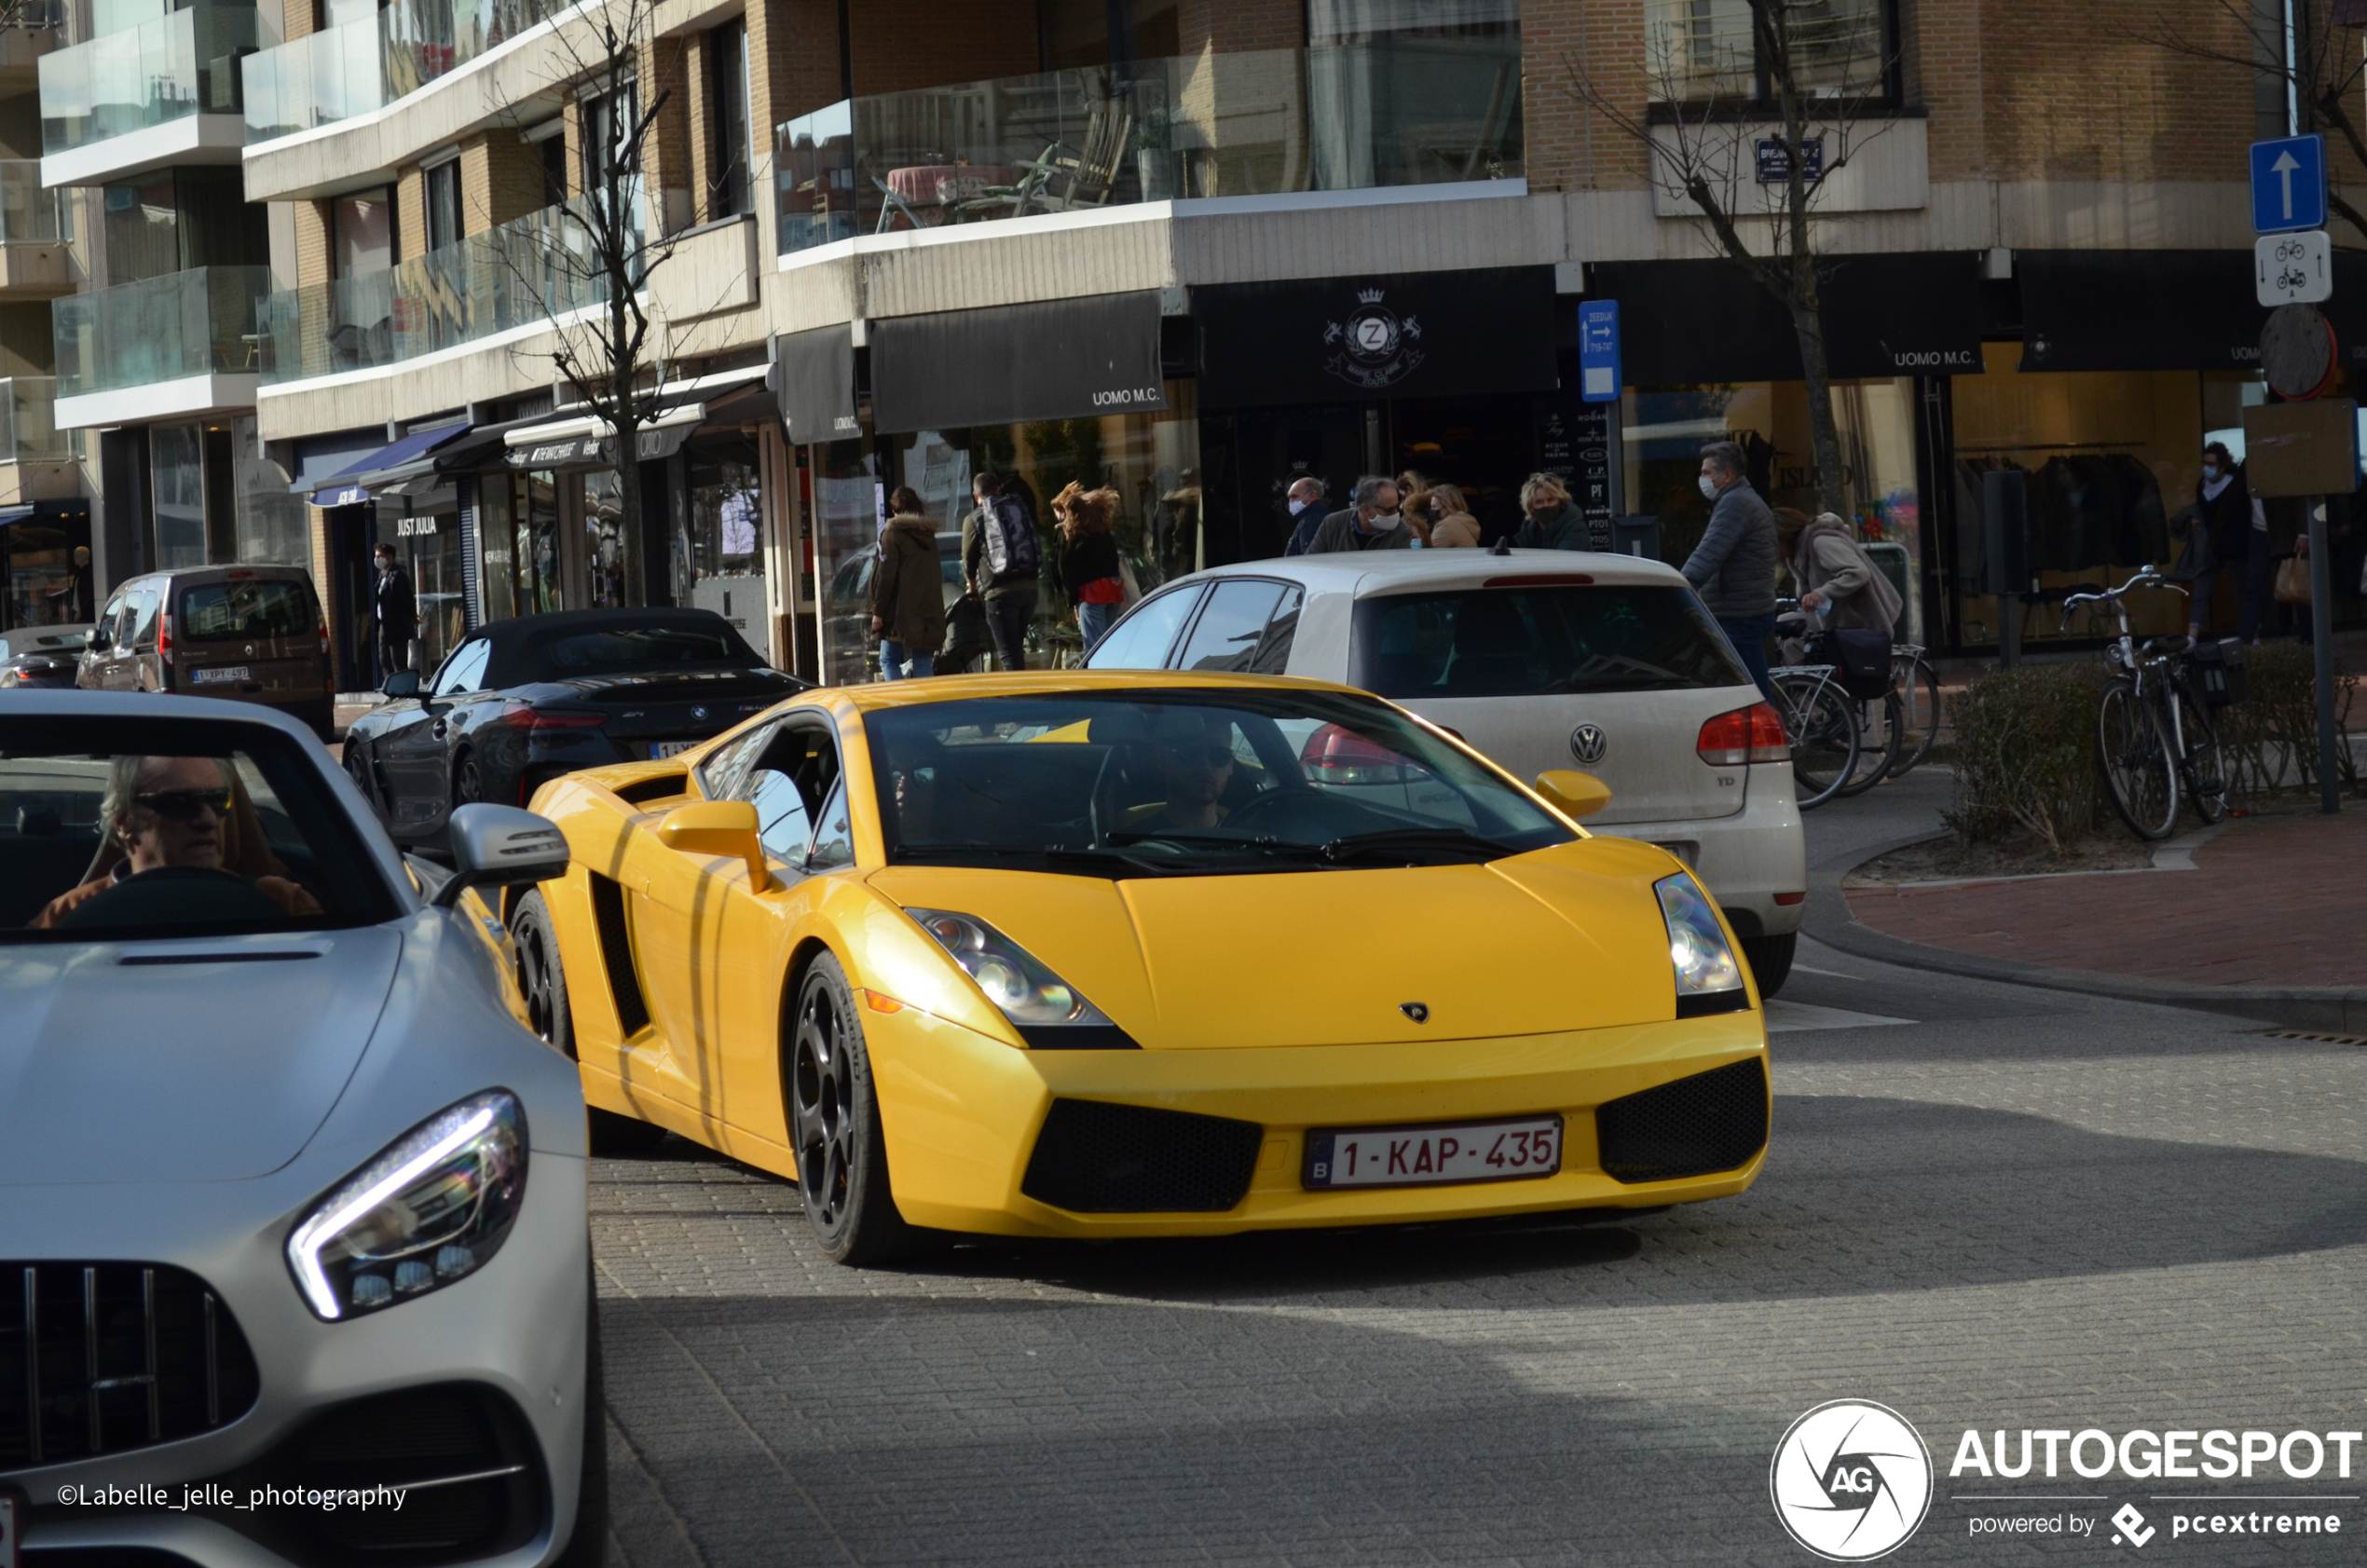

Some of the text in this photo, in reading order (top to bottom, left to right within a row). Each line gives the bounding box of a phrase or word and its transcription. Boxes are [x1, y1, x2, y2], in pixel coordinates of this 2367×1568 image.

[1589, 311, 1613, 322] ZEEDIJK
[1364, 323, 1381, 344] Z
[1895, 350, 1975, 366] UOMO M.C.
[2231, 347, 2261, 360] UOM
[1347, 361, 1402, 378] MARIE CLAIRE
[1362, 375, 1389, 386] ZOUTE
[1093, 388, 1160, 405] UOMO M.C.
[1591, 484, 1603, 498] PT
[398, 516, 437, 537] JUST JULIA
[1313, 1162, 1328, 1179] B
